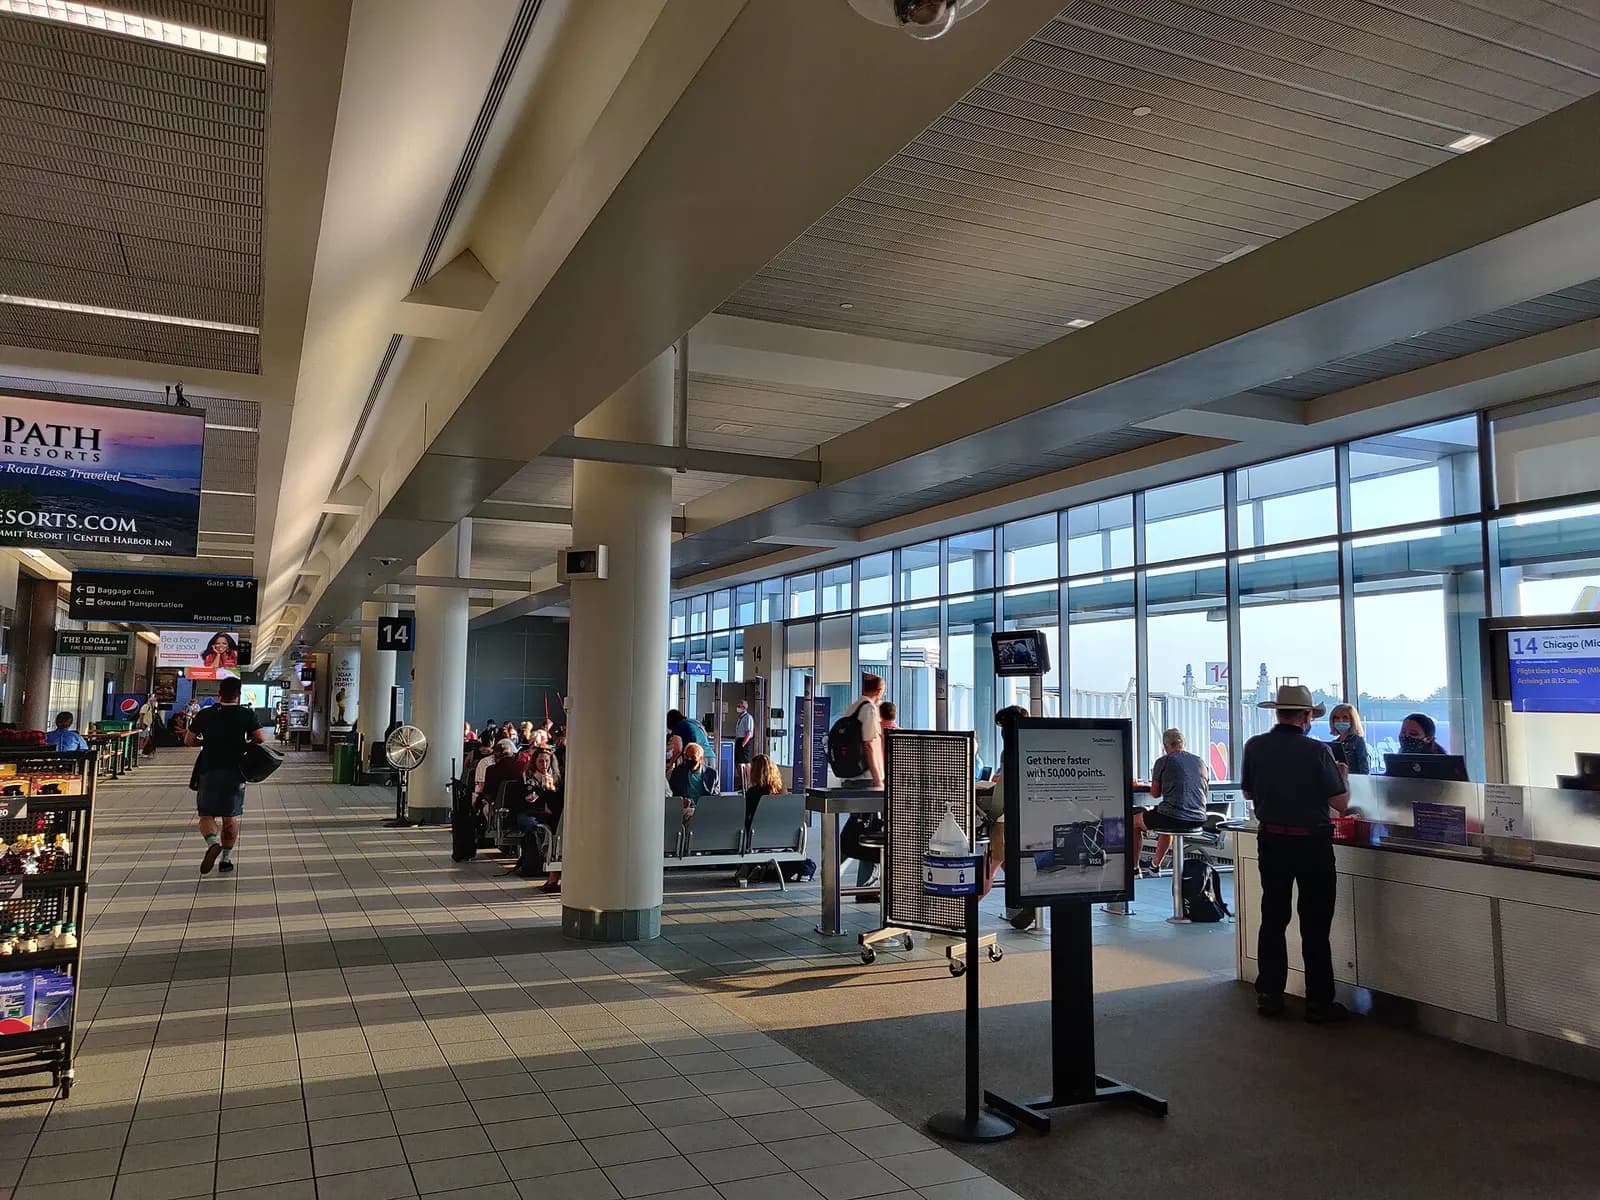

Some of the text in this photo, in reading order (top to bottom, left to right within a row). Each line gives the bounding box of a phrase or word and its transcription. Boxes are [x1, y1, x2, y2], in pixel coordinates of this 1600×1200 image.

[2, 416, 102, 451] PATH
[5, 445, 101, 462] RESORTS
[7, 463, 40, 476] Road
[41, 466, 67, 478] Less
[70, 468, 121, 482] Traveled
[206, 579, 235, 588] Gate 15
[97, 587, 155, 596] Baggage Claim
[96, 599, 184, 609] Ground Transportation
[193, 614, 232, 623] Restrooms
[383, 624, 409, 643] 14
[62, 636, 81, 644] THE
[83, 636, 111, 645] LOCAL
[161, 634, 173, 643] Be
[179, 635, 200, 644] force
[175, 643, 196, 653] good
[1513, 637, 1539, 655] 14
[1543, 639, 1579, 651] Chicago
[752, 646, 762, 662] 14
[1559, 667, 1586, 675] Chicago
[1026, 755, 1091, 765] Get there faster
[1026, 767, 1106, 780] with 50,000 points.
